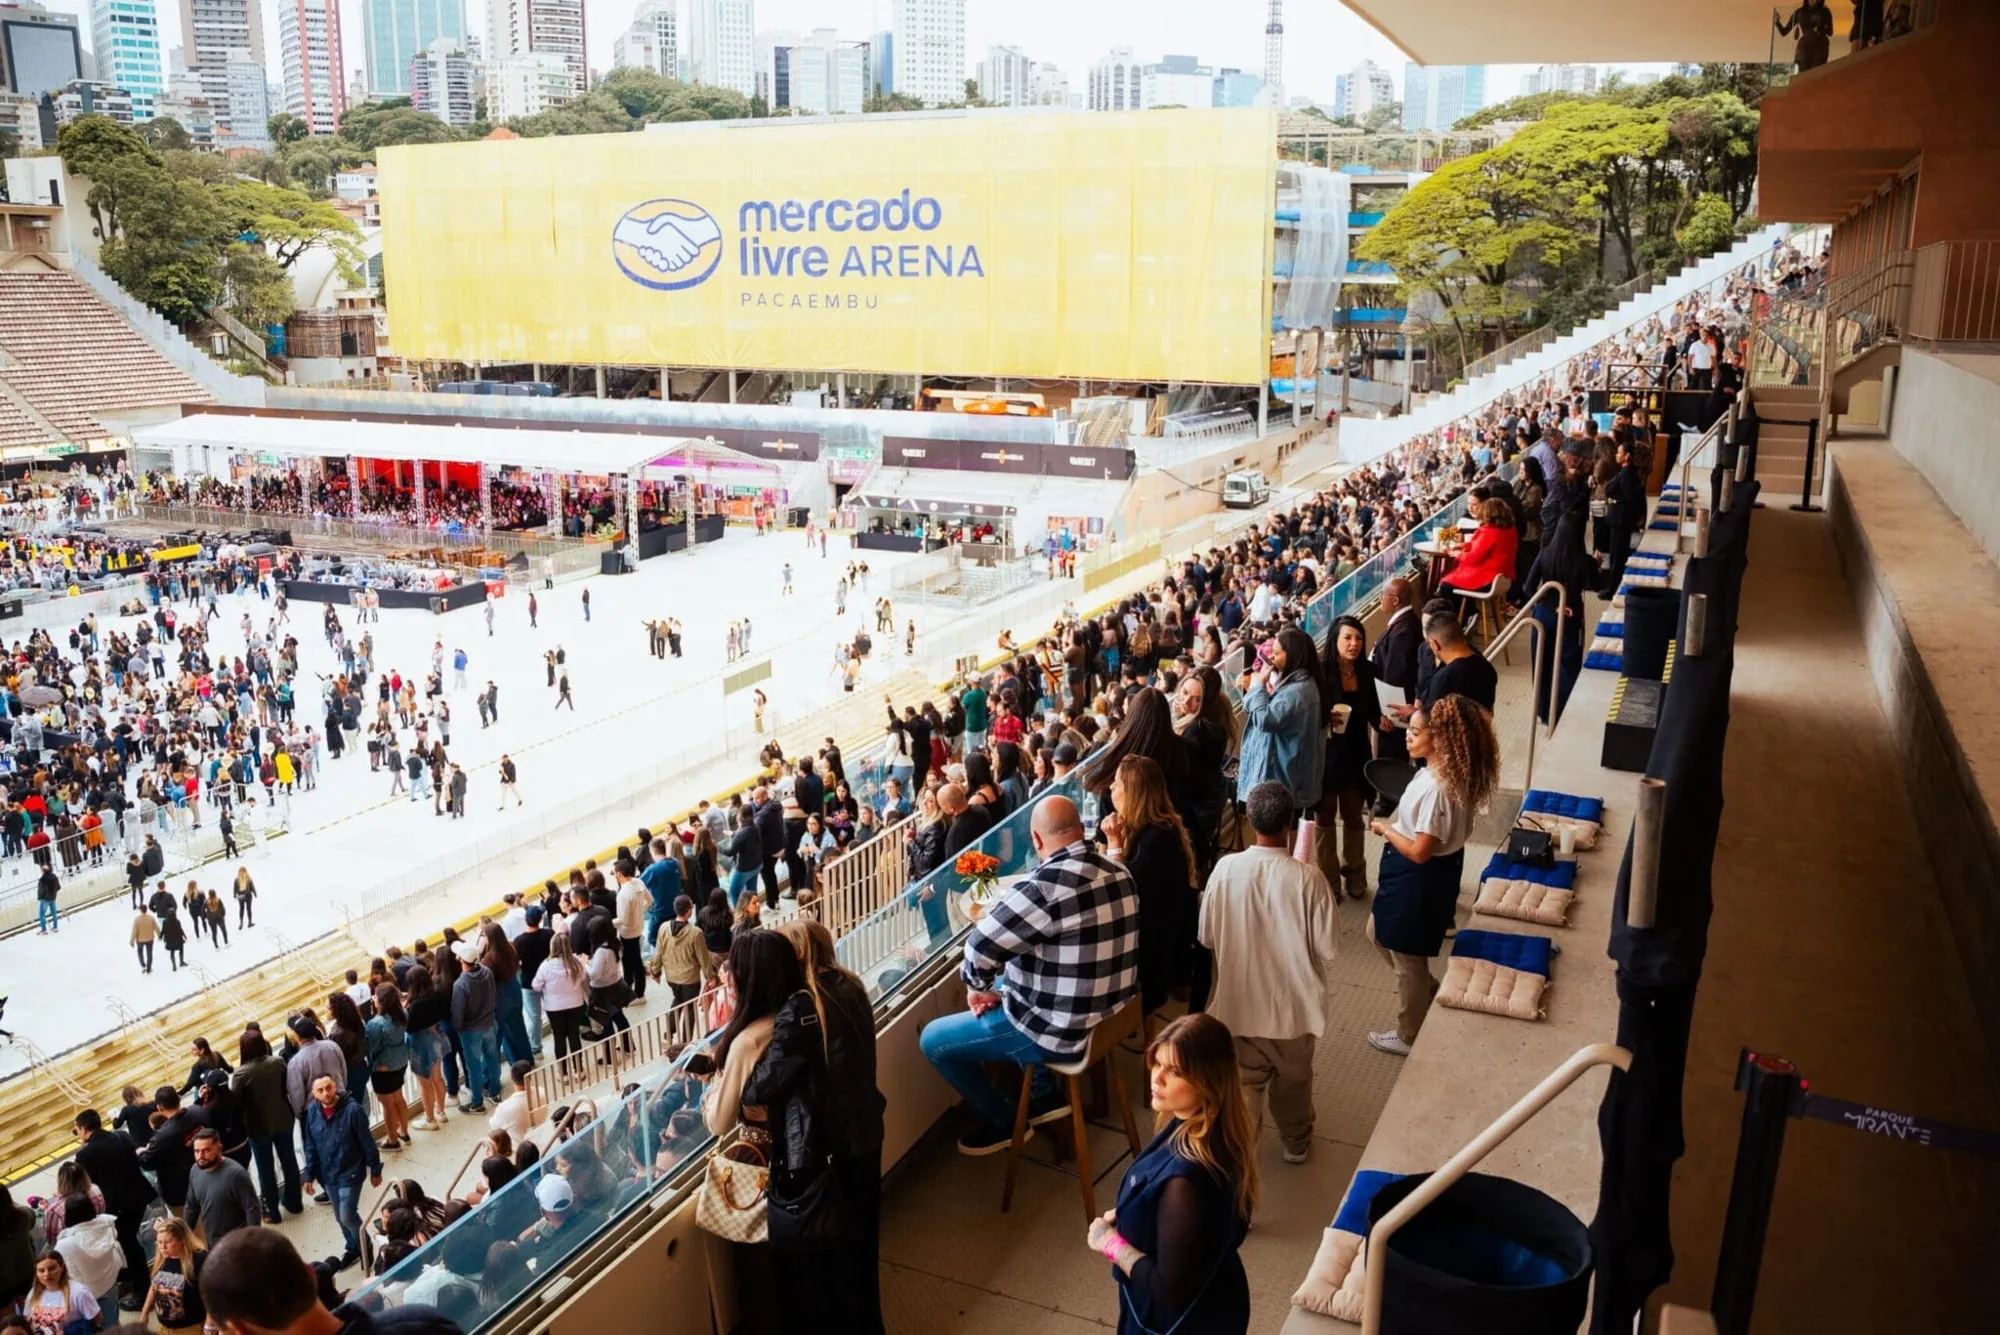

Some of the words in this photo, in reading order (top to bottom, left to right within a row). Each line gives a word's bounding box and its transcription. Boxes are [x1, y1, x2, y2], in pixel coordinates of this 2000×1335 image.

[739, 188, 942, 232] mercado
[739, 236, 829, 277] livre
[839, 245, 985, 277] ARENA
[741, 292, 878, 309] PACAEMBU
[1844, 1112, 1931, 1145] MIRANTE
[1866, 1107, 1914, 1124] PARQUE
